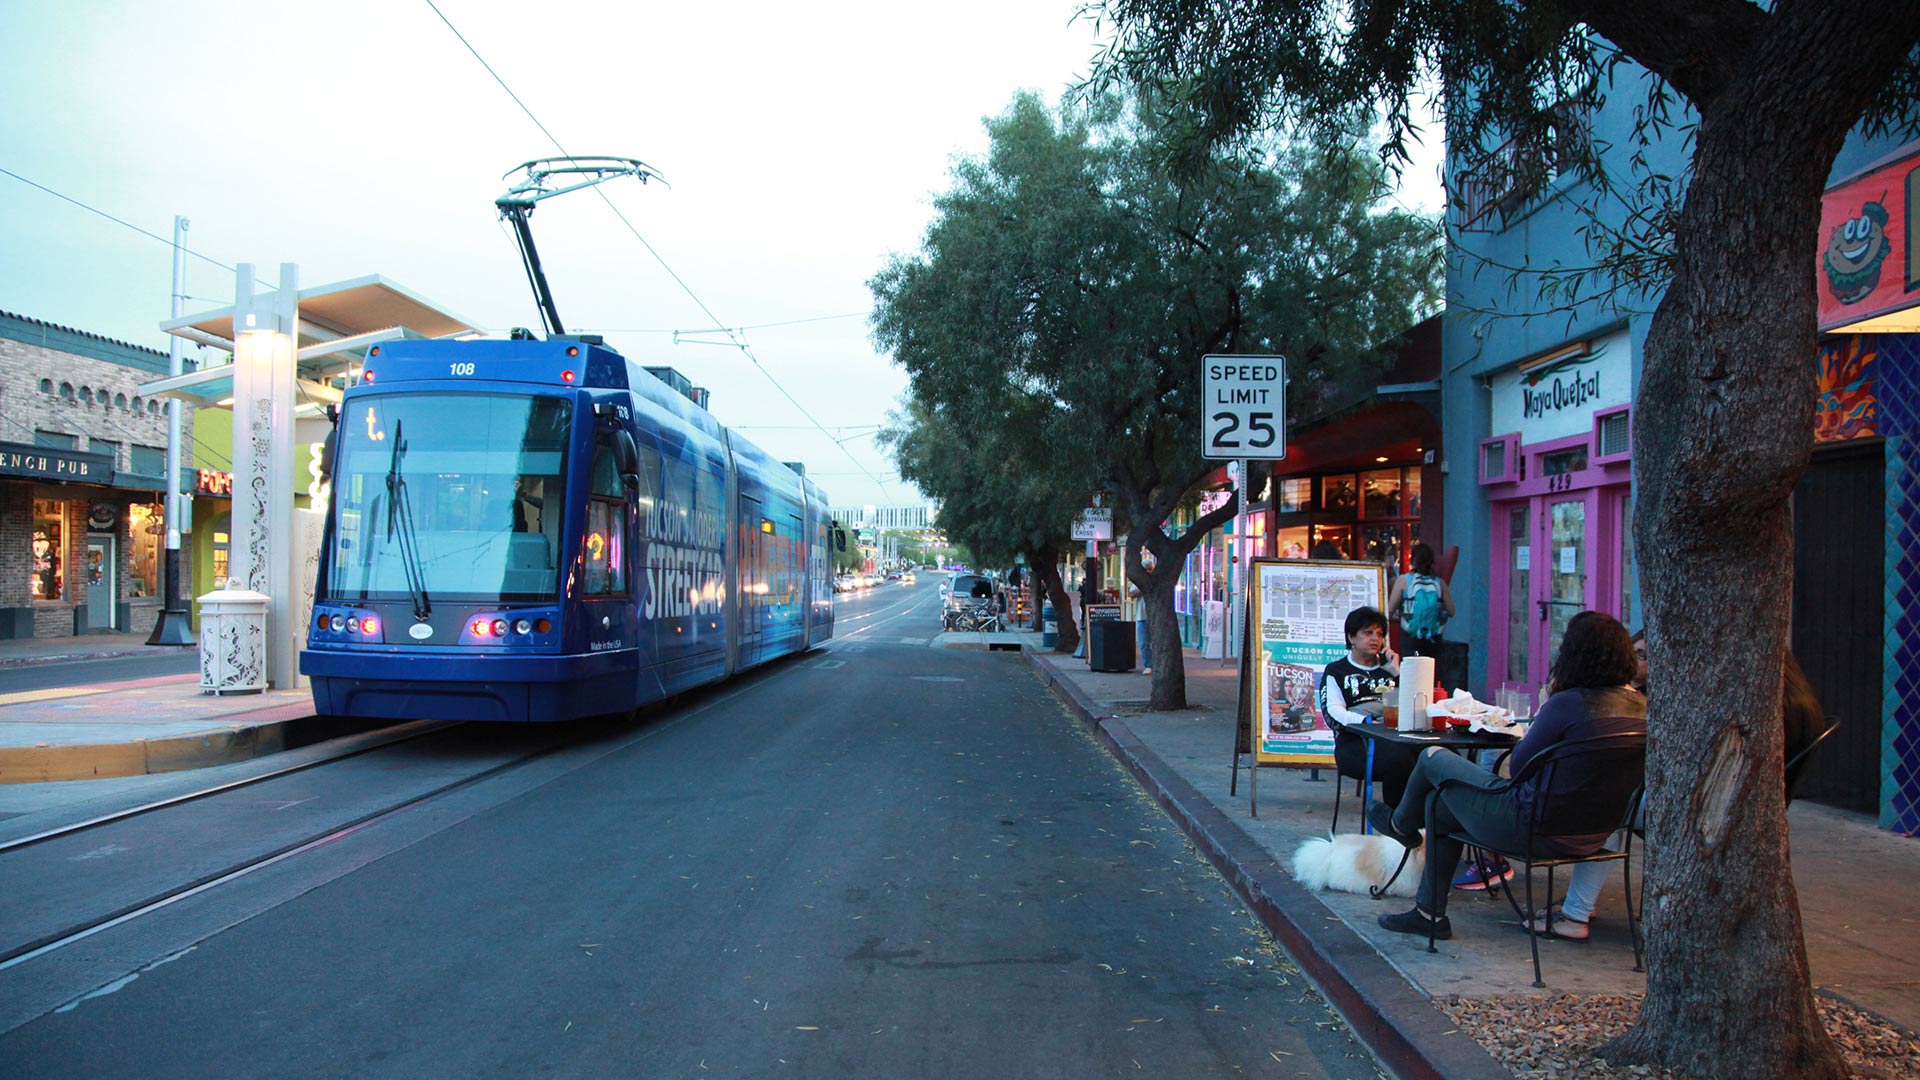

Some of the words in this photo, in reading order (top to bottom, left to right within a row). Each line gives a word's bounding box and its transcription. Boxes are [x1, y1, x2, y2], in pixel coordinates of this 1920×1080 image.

[449, 362, 476, 376] 108
[1210, 365, 1277, 381] SPEED
[1217, 388, 1269, 405] LIMIT
[1212, 411, 1276, 449] 25
[57, 459, 88, 475] PUB
[1549, 473, 1572, 493] 429
[645, 543, 722, 620] STREETCAR
[1286, 646, 1324, 655] TUCSON
[1326, 648, 1352, 656] GUID
[1267, 664, 1313, 681] TUCSON
